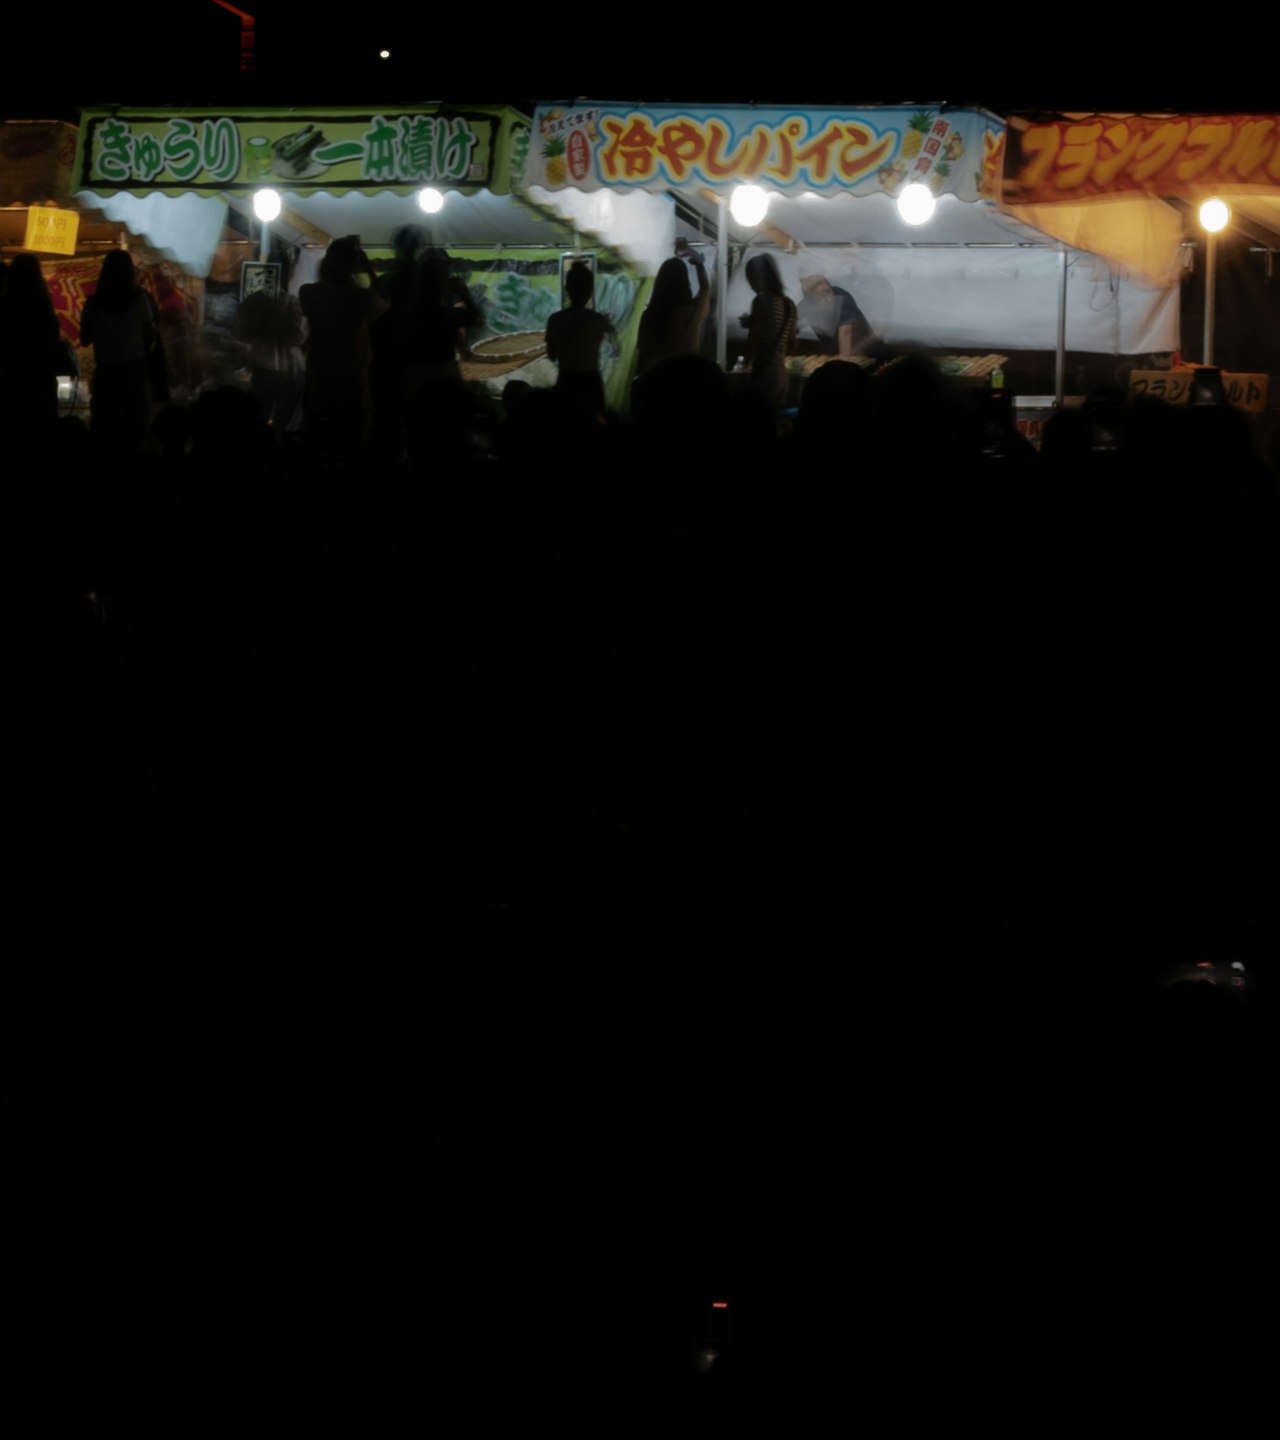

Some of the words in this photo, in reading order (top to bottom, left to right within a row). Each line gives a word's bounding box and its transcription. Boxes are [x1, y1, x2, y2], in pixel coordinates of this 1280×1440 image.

[98, 118, 241, 181] きゅうり
[313, 116, 476, 180] 一本漬け
[601, 116, 899, 181] 冷やしパイン
[1132, 379, 1260, 403] フランルト
